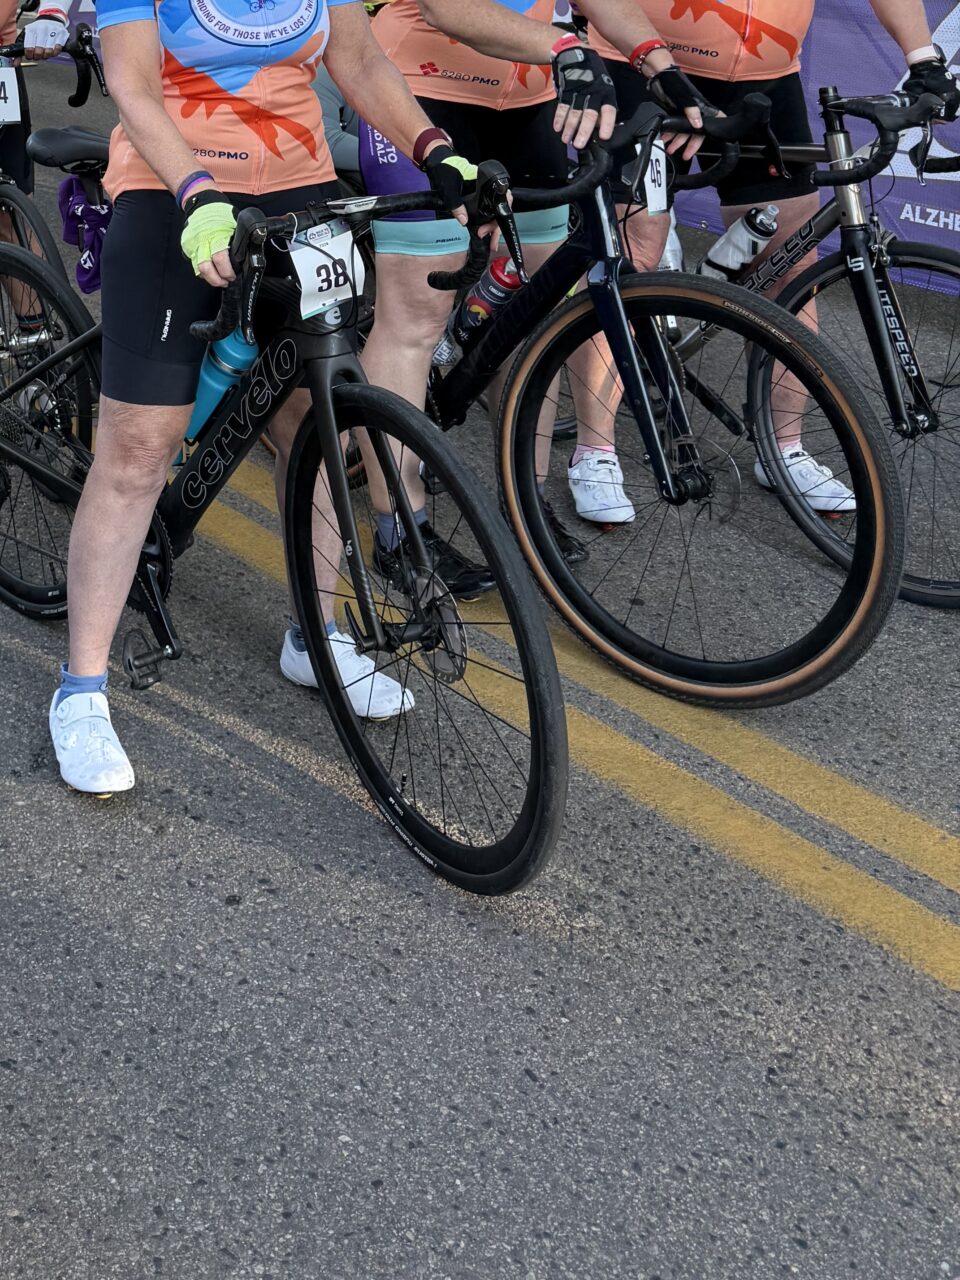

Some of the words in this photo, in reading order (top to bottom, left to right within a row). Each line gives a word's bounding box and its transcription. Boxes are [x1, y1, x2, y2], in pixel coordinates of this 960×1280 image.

[214, 20, 230, 34] FOR
[233, 28, 261, 40] THOSE
[264, 25, 290, 39] WE'VE
[691, 47, 720, 58] PMO
[440, 69, 471, 81] 5280
[471, 76, 500, 86] PMO
[193, 148, 216, 158] 280
[218, 151, 249, 160] PMO
[375, 142, 388, 164] ALZ
[386, 145, 398, 163] TO
[650, 158, 662, 188] 46
[316, 258, 349, 293] 38
[247, 271, 259, 321] ULTEGRA
[182, 338, 297, 509] cervélo
